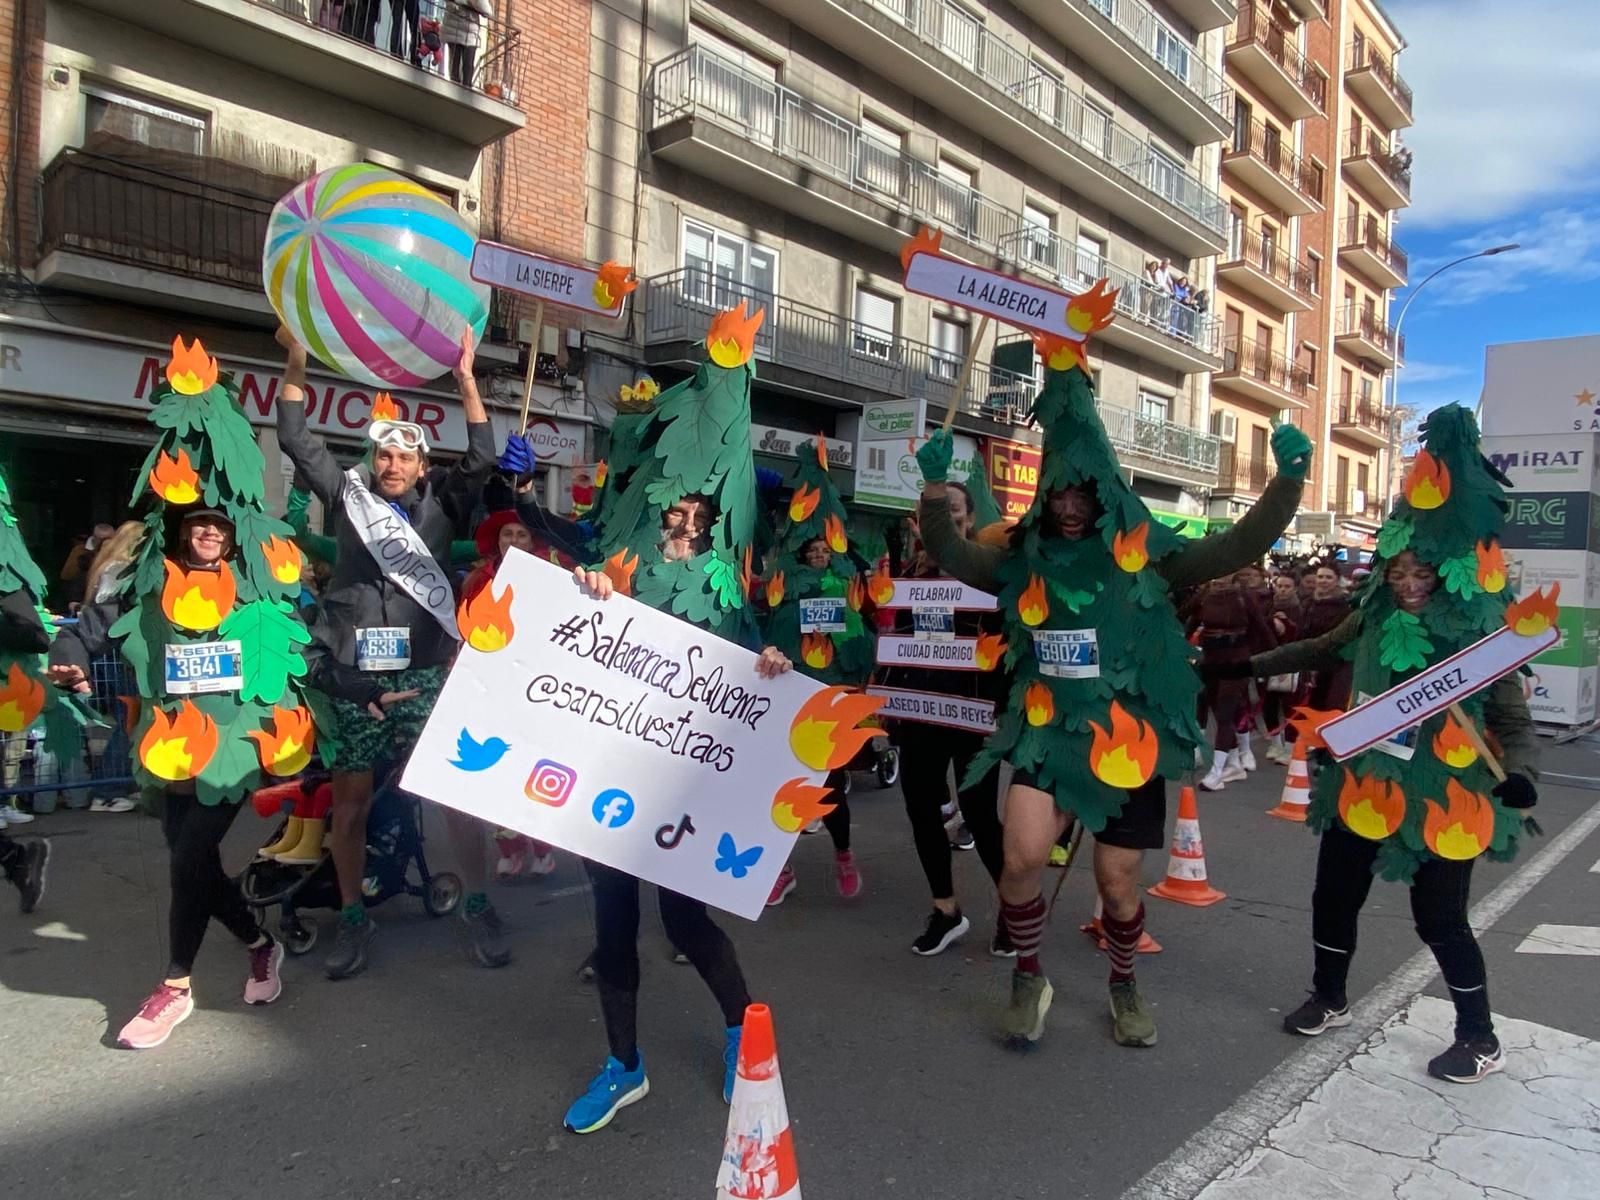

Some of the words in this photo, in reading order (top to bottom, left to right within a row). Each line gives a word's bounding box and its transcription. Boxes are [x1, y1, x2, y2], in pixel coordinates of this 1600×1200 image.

[515, 263, 530, 285] LA
[532, 268, 575, 296] SIERPE
[957, 275, 977, 297] LA
[977, 282, 1048, 320] ALBERCA
[909, 587, 963, 601] PELABRAVO
[807, 607, 836, 621] 5257
[367, 630, 405, 638] SETEL
[1047, 633, 1089, 641] SETEL
[183, 643, 236, 657] SETEL
[360, 639, 398, 657] 4638
[897, 643, 931, 659] CIUDAD
[933, 645, 973, 661] RODRIGO
[1040, 642, 1082, 663] 5902
[176, 655, 221, 678] 3641
[1396, 667, 1469, 714] CIPÉREZ
[922, 700, 936, 716] DE
[938, 703, 958, 718] LOS
[960, 706, 995, 725] REYES
